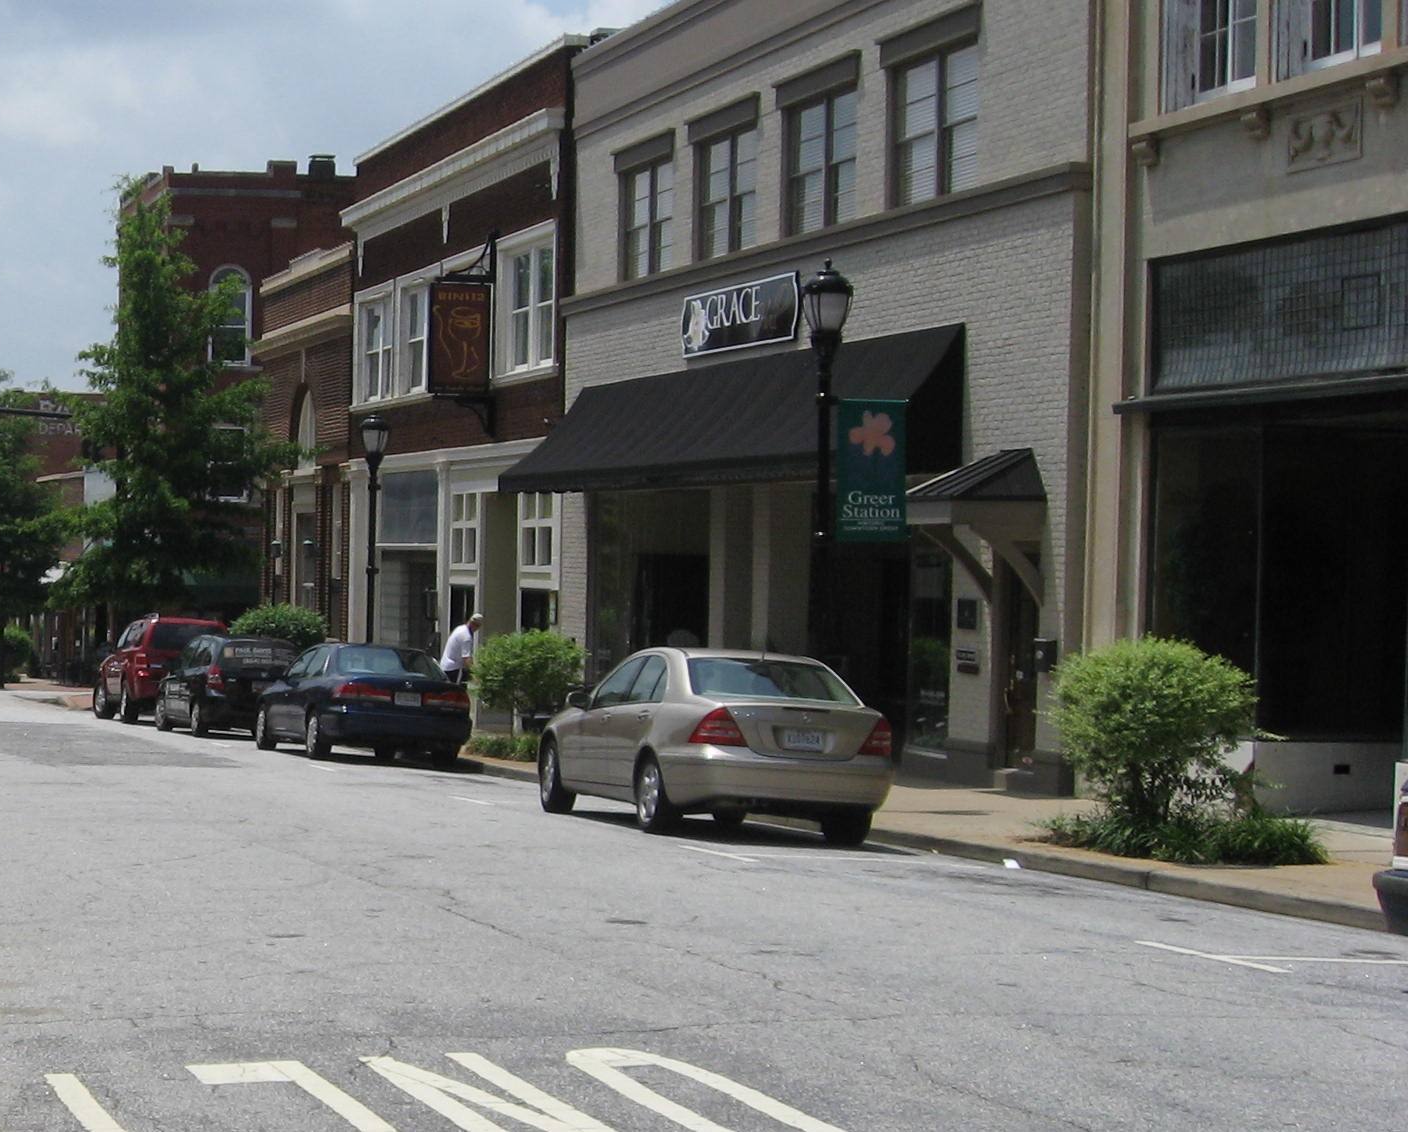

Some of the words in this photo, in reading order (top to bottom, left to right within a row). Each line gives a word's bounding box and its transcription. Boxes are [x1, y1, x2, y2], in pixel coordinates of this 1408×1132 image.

[706, 286, 761, 330] GRACE
[848, 490, 896, 504] Greer
[842, 504, 900, 518] Station
